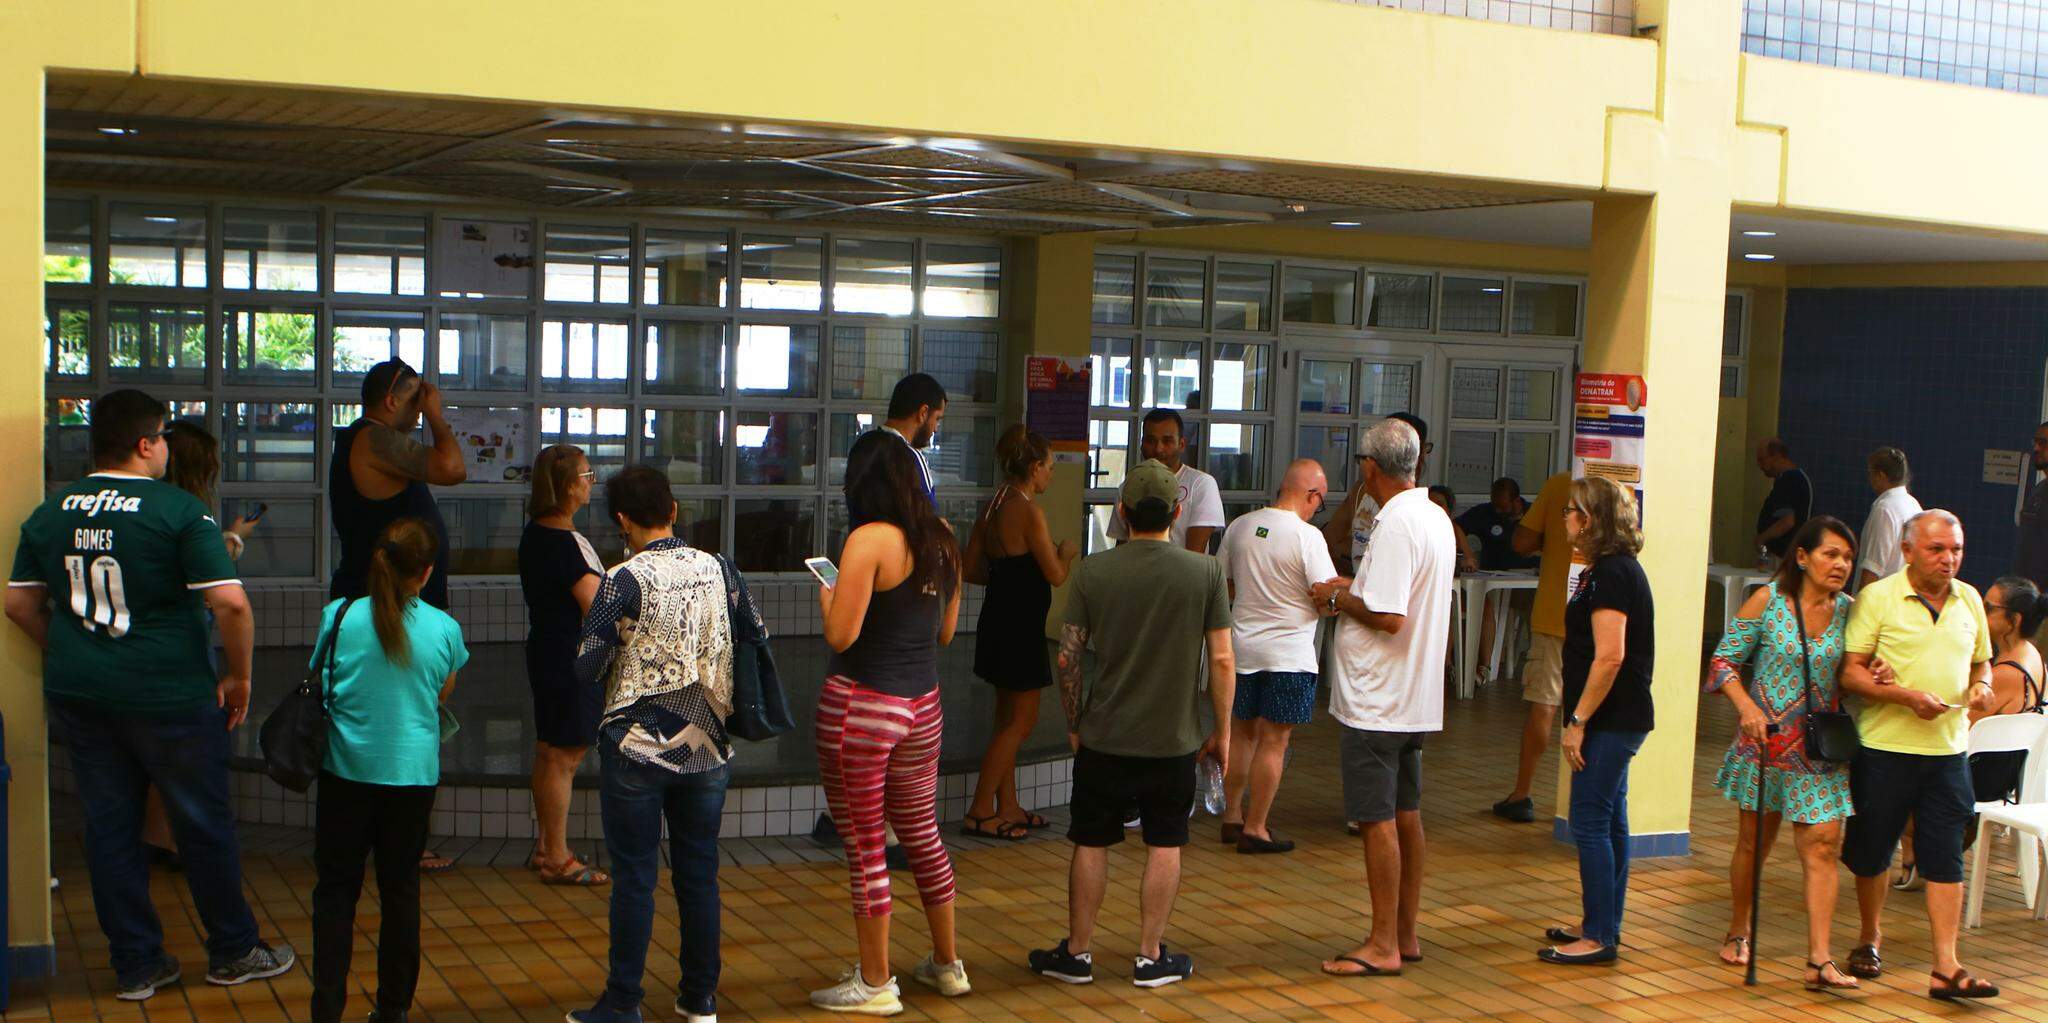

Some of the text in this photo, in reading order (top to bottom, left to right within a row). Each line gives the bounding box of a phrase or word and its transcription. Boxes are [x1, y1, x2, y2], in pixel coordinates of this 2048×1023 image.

[1580, 387, 1614, 396] DENATRAN
[62, 489, 142, 517] crefisa
[74, 528, 114, 551] GOMES
[64, 555, 132, 638] 10
